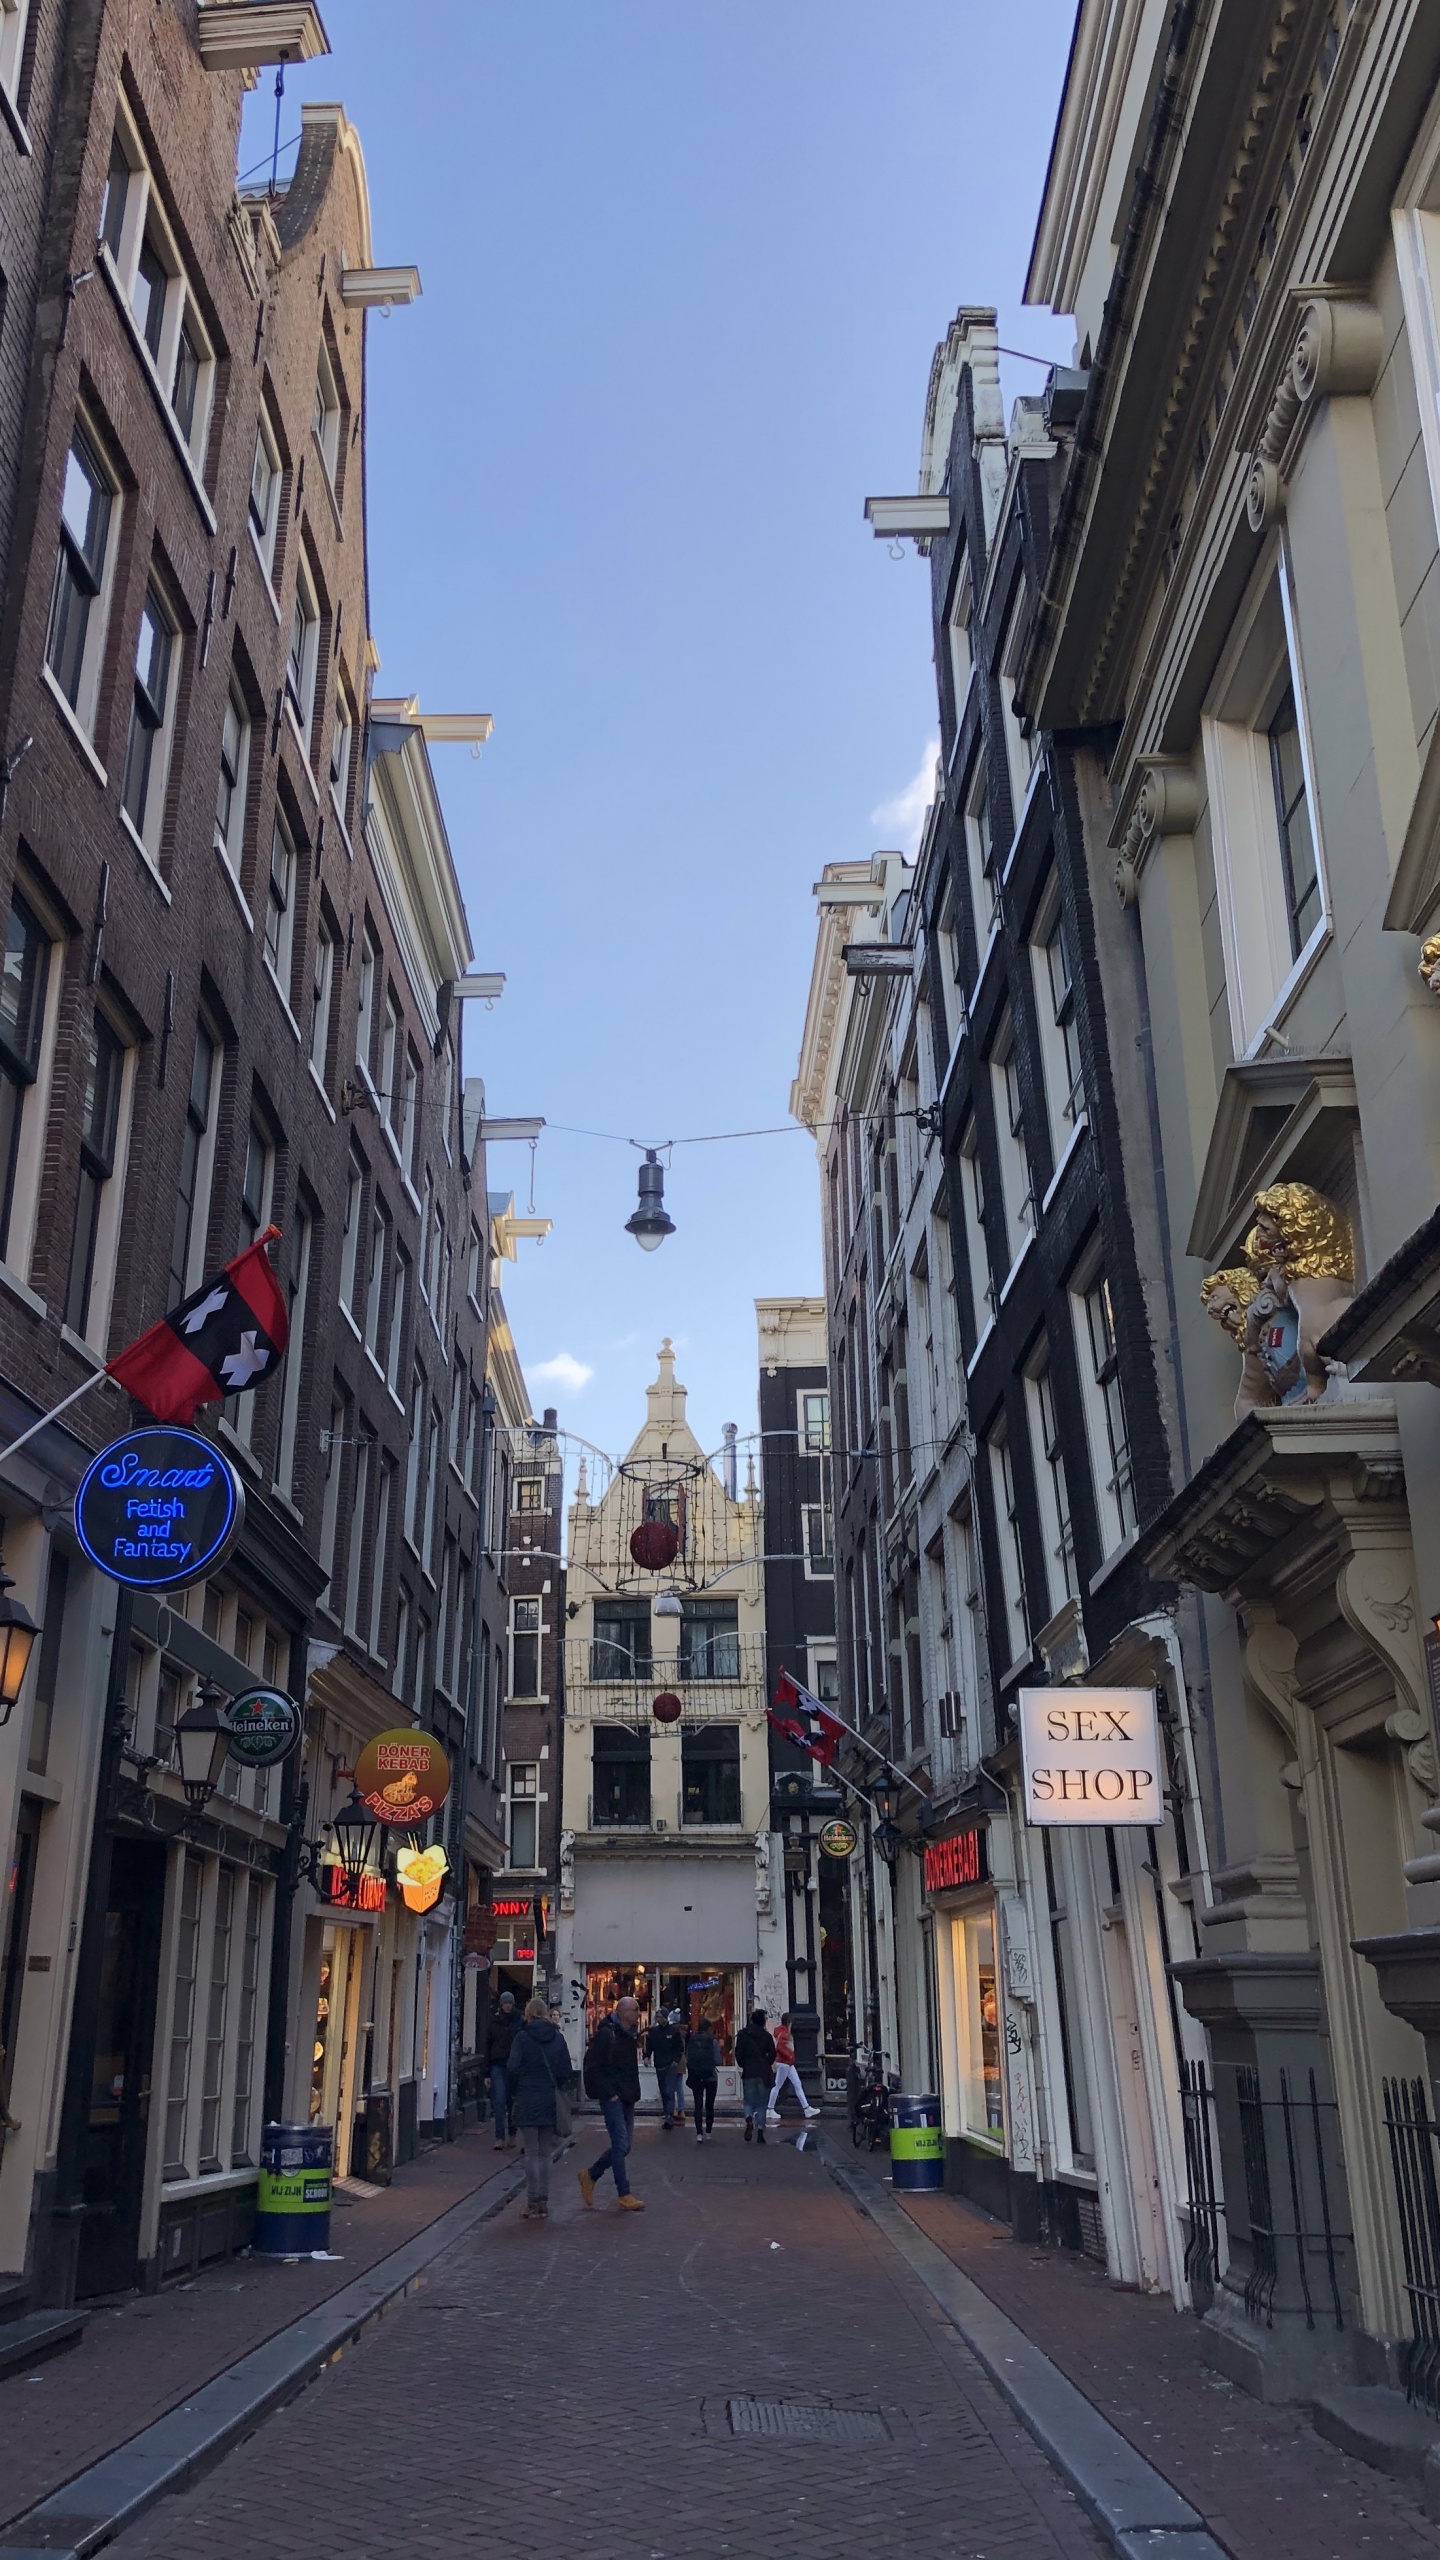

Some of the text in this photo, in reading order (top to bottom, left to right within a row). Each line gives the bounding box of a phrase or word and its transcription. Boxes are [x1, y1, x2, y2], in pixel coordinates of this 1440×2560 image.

[101, 1453, 215, 1488] Smart
[127, 1497, 185, 1518] Fetish
[137, 1520, 171, 1538] and
[114, 1538, 192, 1564] Fantasy
[231, 1720, 289, 1732] Heineken
[1047, 1710, 1134, 1741] SEX
[377, 1743, 431, 1758] DÖNER
[377, 1757, 430, 1771] KEBAB
[1032, 1768, 1153, 1801] SHOP
[365, 1791, 433, 1821] PIZZA'S
